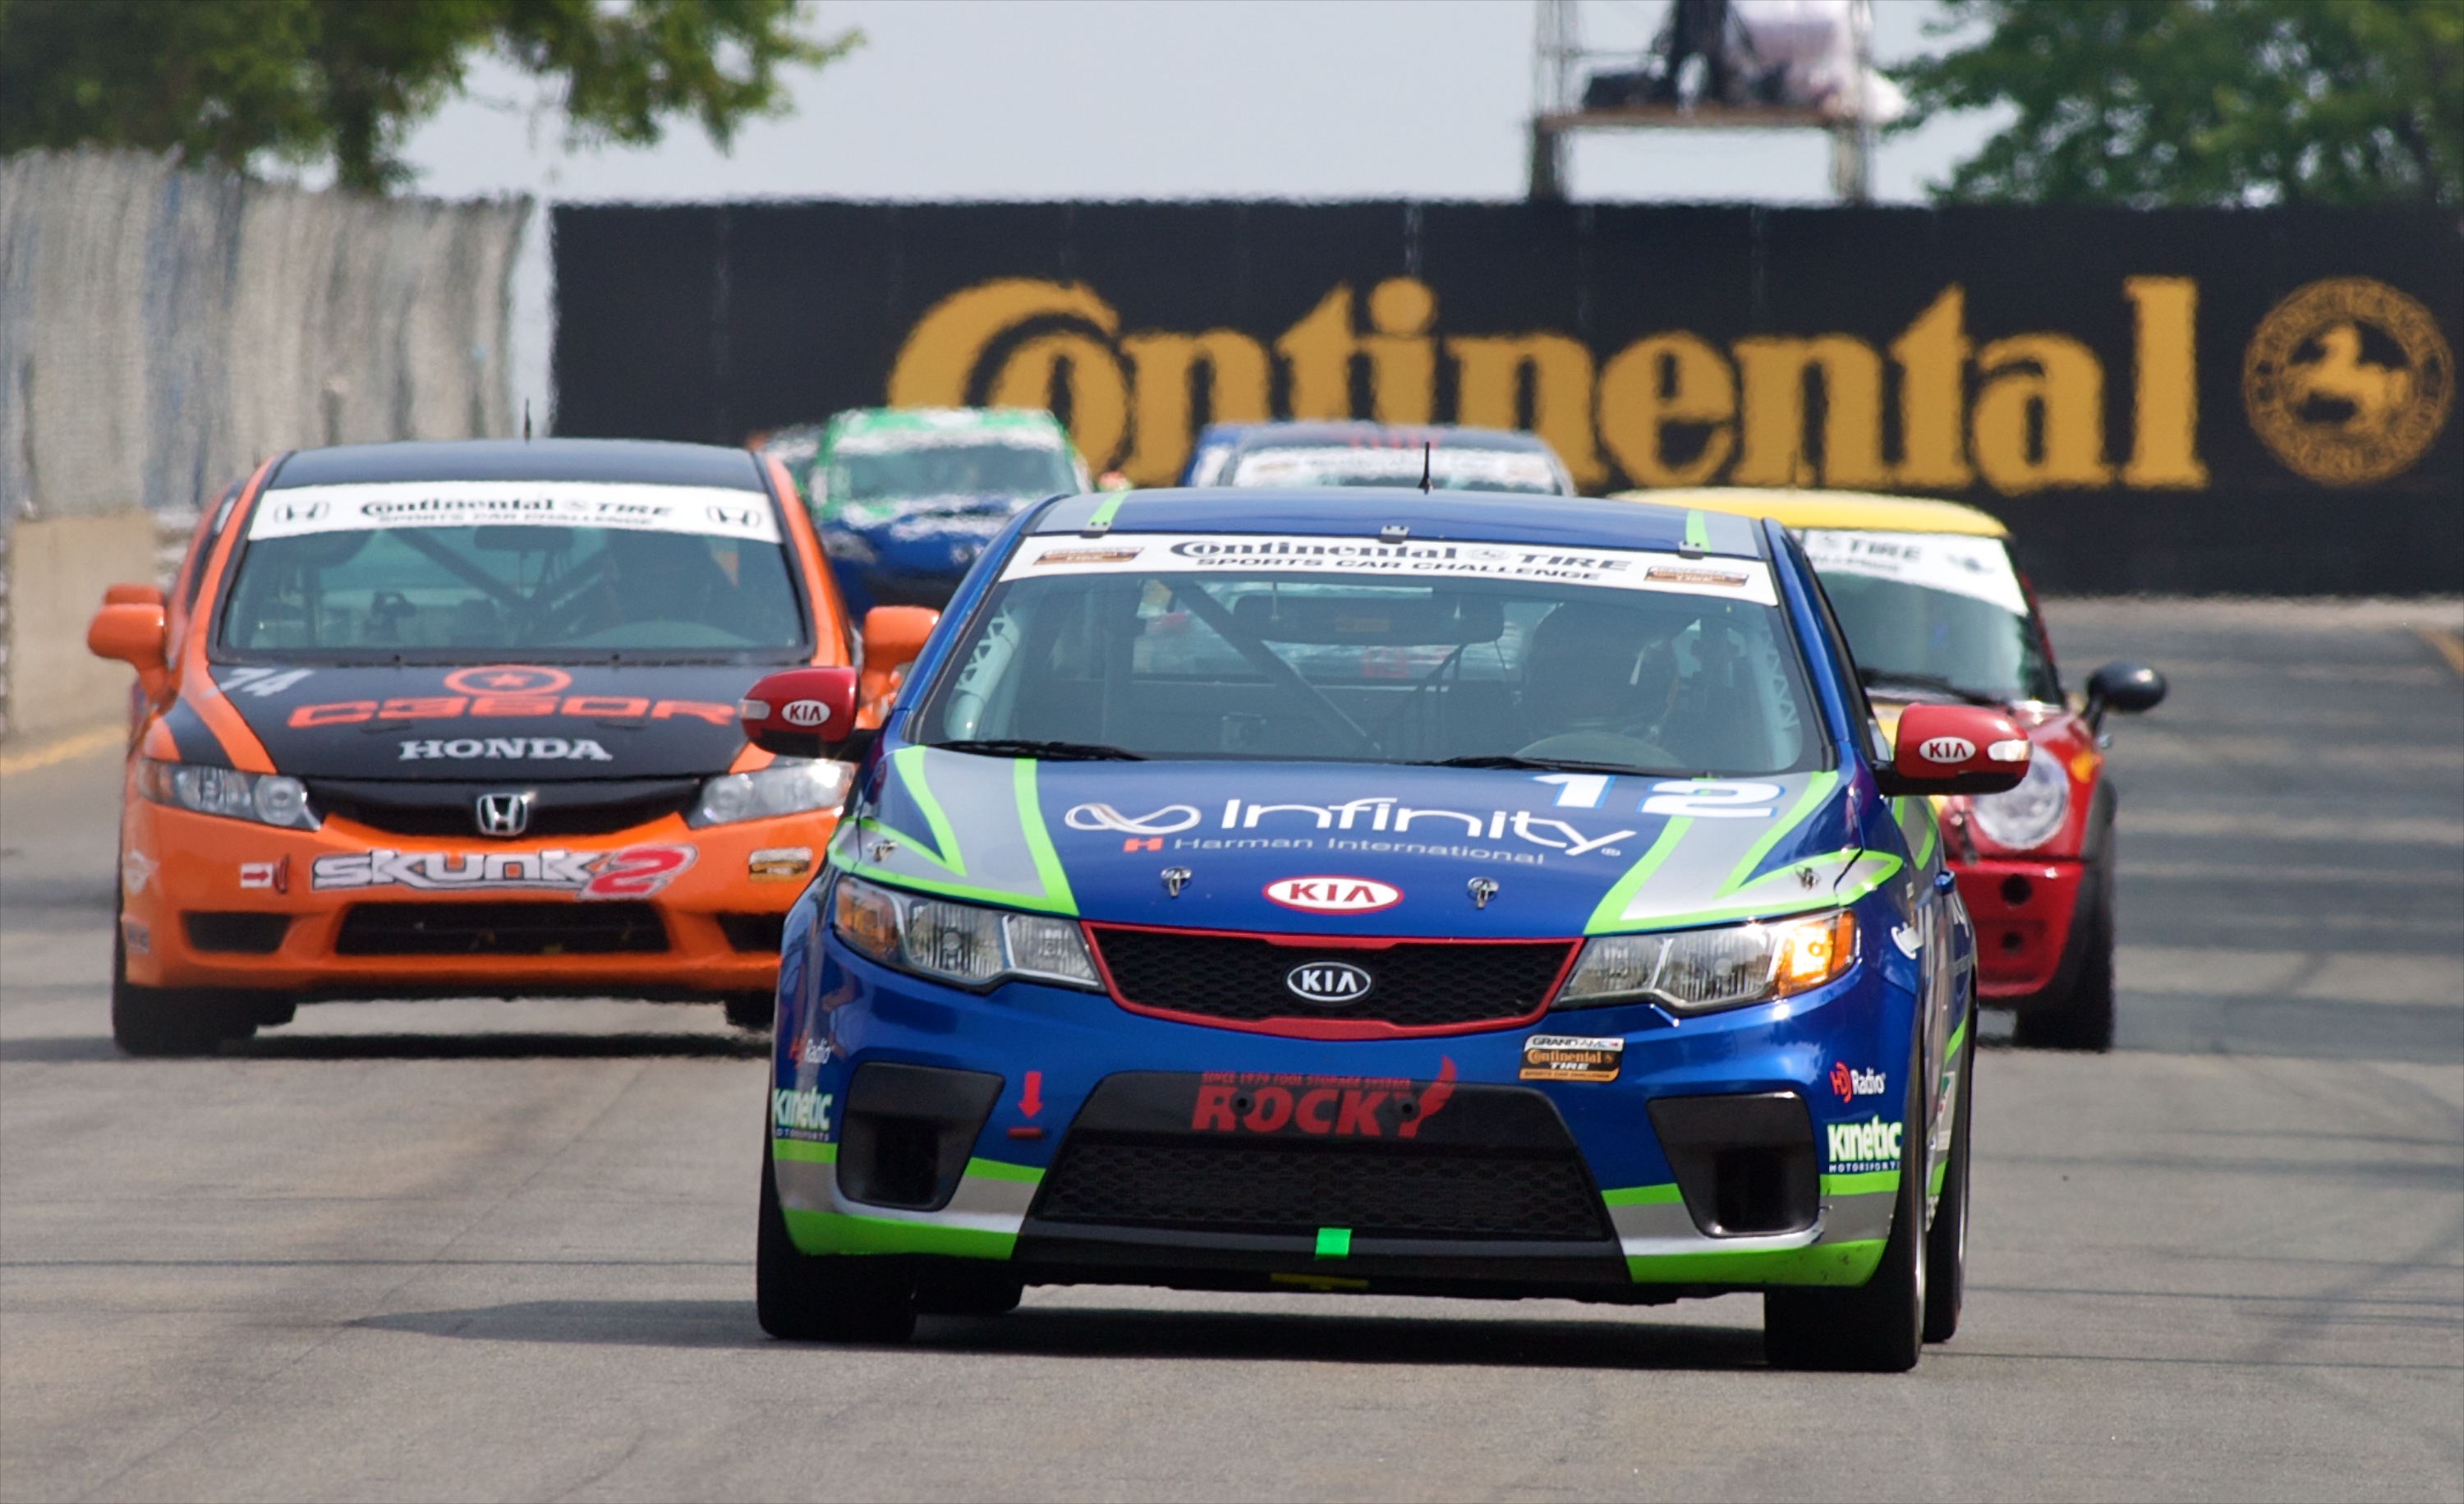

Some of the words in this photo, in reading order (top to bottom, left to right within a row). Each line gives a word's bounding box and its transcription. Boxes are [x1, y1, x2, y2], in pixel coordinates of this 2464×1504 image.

[886, 278, 2208, 493] Continental
[360, 499, 554, 516] Continental
[595, 502, 673, 516] TIRE
[1170, 540, 1457, 559] Continental
[1518, 553, 1633, 571] TIRE
[1196, 558, 1296, 567] SPORTS
[1335, 559, 1401, 569] CAR
[1411, 562, 1602, 580] CHALLENGE
[789, 704, 821, 721] KIA
[398, 738, 614, 761] HONDA
[1928, 742, 1968, 758] KIA
[1174, 838, 1313, 849] Harman
[1327, 838, 1544, 865] International
[1289, 883, 1377, 904] KIA
[1302, 969, 1358, 993] KIA
[1527, 1049, 1602, 1065] Continental
[1550, 1061, 1589, 1070] TIRE
